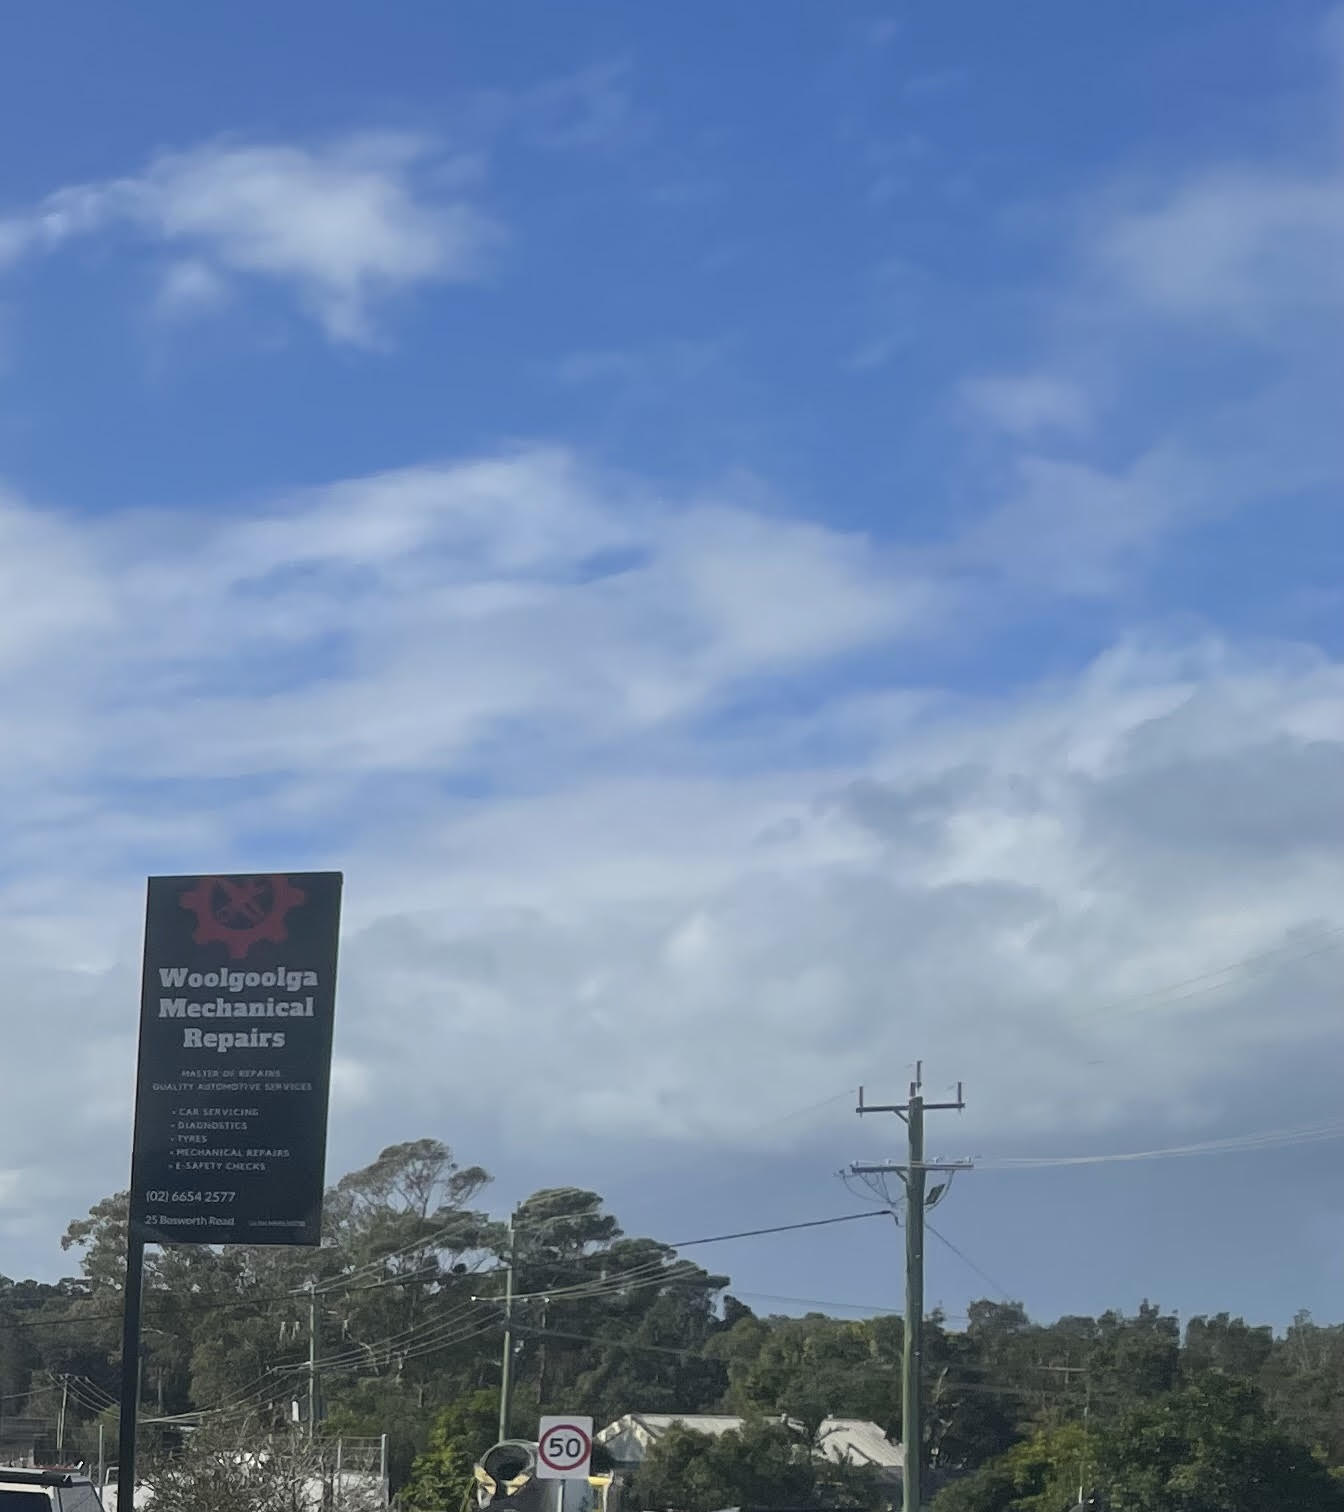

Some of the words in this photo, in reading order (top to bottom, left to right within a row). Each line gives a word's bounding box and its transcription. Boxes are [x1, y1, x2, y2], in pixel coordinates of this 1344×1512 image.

[159, 967, 318, 992] Woolgoolga
[159, 997, 314, 1018] Mechanical
[183, 1028, 285, 1052] Repairs
[181, 1070, 219, 1078] MASTER
[239, 1070, 281, 1078] REPAIRS
[152, 1083, 194, 1091] QUALITY
[198, 1083, 261, 1091] AUTOMOTIVE
[265, 1083, 312, 1091] SERVICES
[179, 1108, 199, 1116] CAR
[203, 1108, 259, 1116] SERVICING
[177, 1122, 248, 1130] DIAGNOSTICS
[177, 1135, 208, 1143] TYRES
[176, 1149, 243, 1157] MECHANICAL
[246, 1149, 290, 1157] REPAIRS
[175, 1162, 223, 1170] E-SAFETY
[225, 1162, 266, 1170] CHECKS
[146, 1191, 169, 1203] (02)
[171, 1191, 202, 1202] 6654
[204, 1192, 236, 1202] 2577
[144, 1215, 157, 1225] 25
[209, 1216, 235, 1226] Road
[549, 1438, 581, 1458] 50
